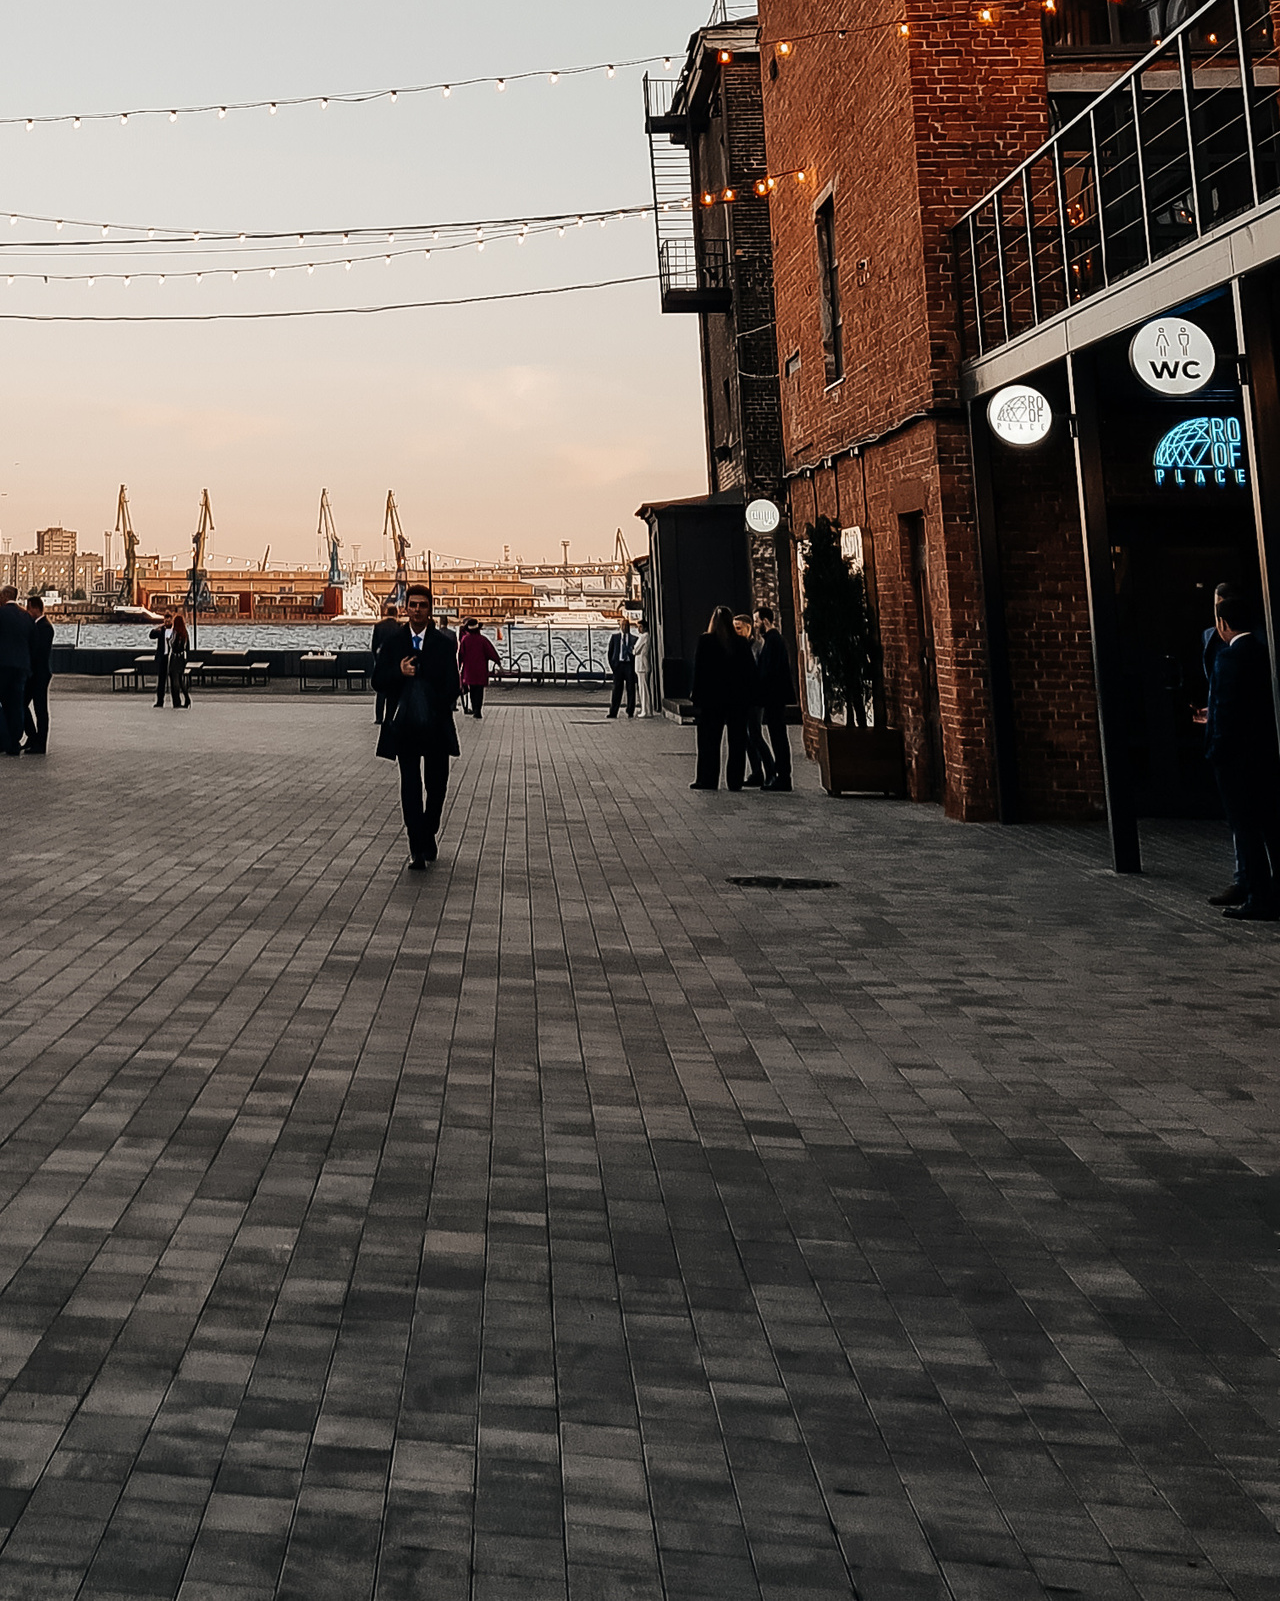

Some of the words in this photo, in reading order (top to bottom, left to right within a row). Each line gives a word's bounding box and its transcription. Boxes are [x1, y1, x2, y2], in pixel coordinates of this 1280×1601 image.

[1149, 360, 1201, 380] WC
[996, 422, 1046, 432] PLACE
[1155, 468, 1246, 484] PLACE
